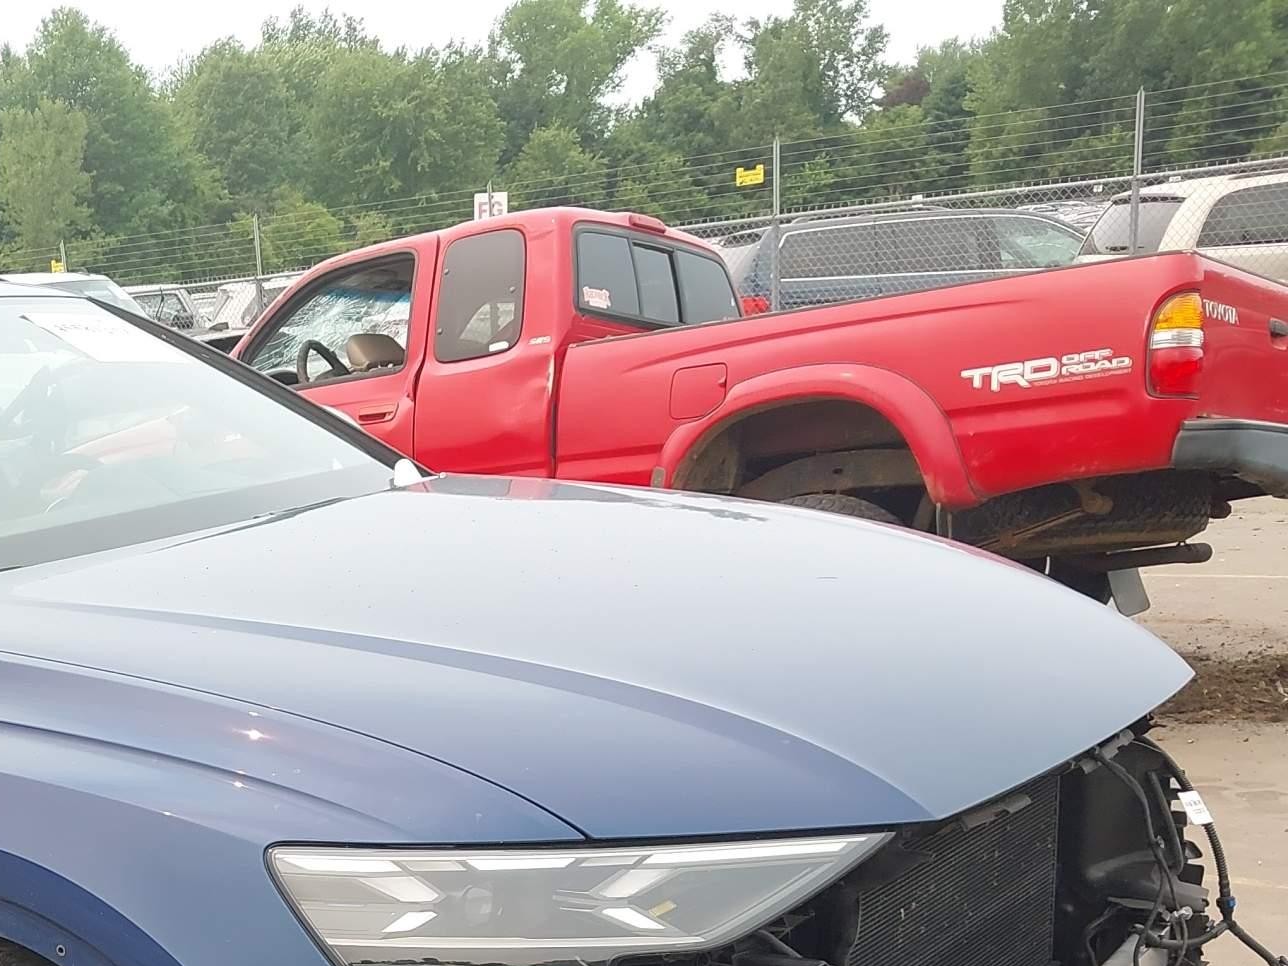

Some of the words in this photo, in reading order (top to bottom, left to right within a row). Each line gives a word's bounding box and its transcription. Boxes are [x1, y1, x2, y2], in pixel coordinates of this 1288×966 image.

[1203, 298, 1239, 326] TOYOTA
[1061, 348, 1113, 364] OFF
[1061, 356, 1133, 376] ROAD
[961, 357, 1060, 392] TRD
